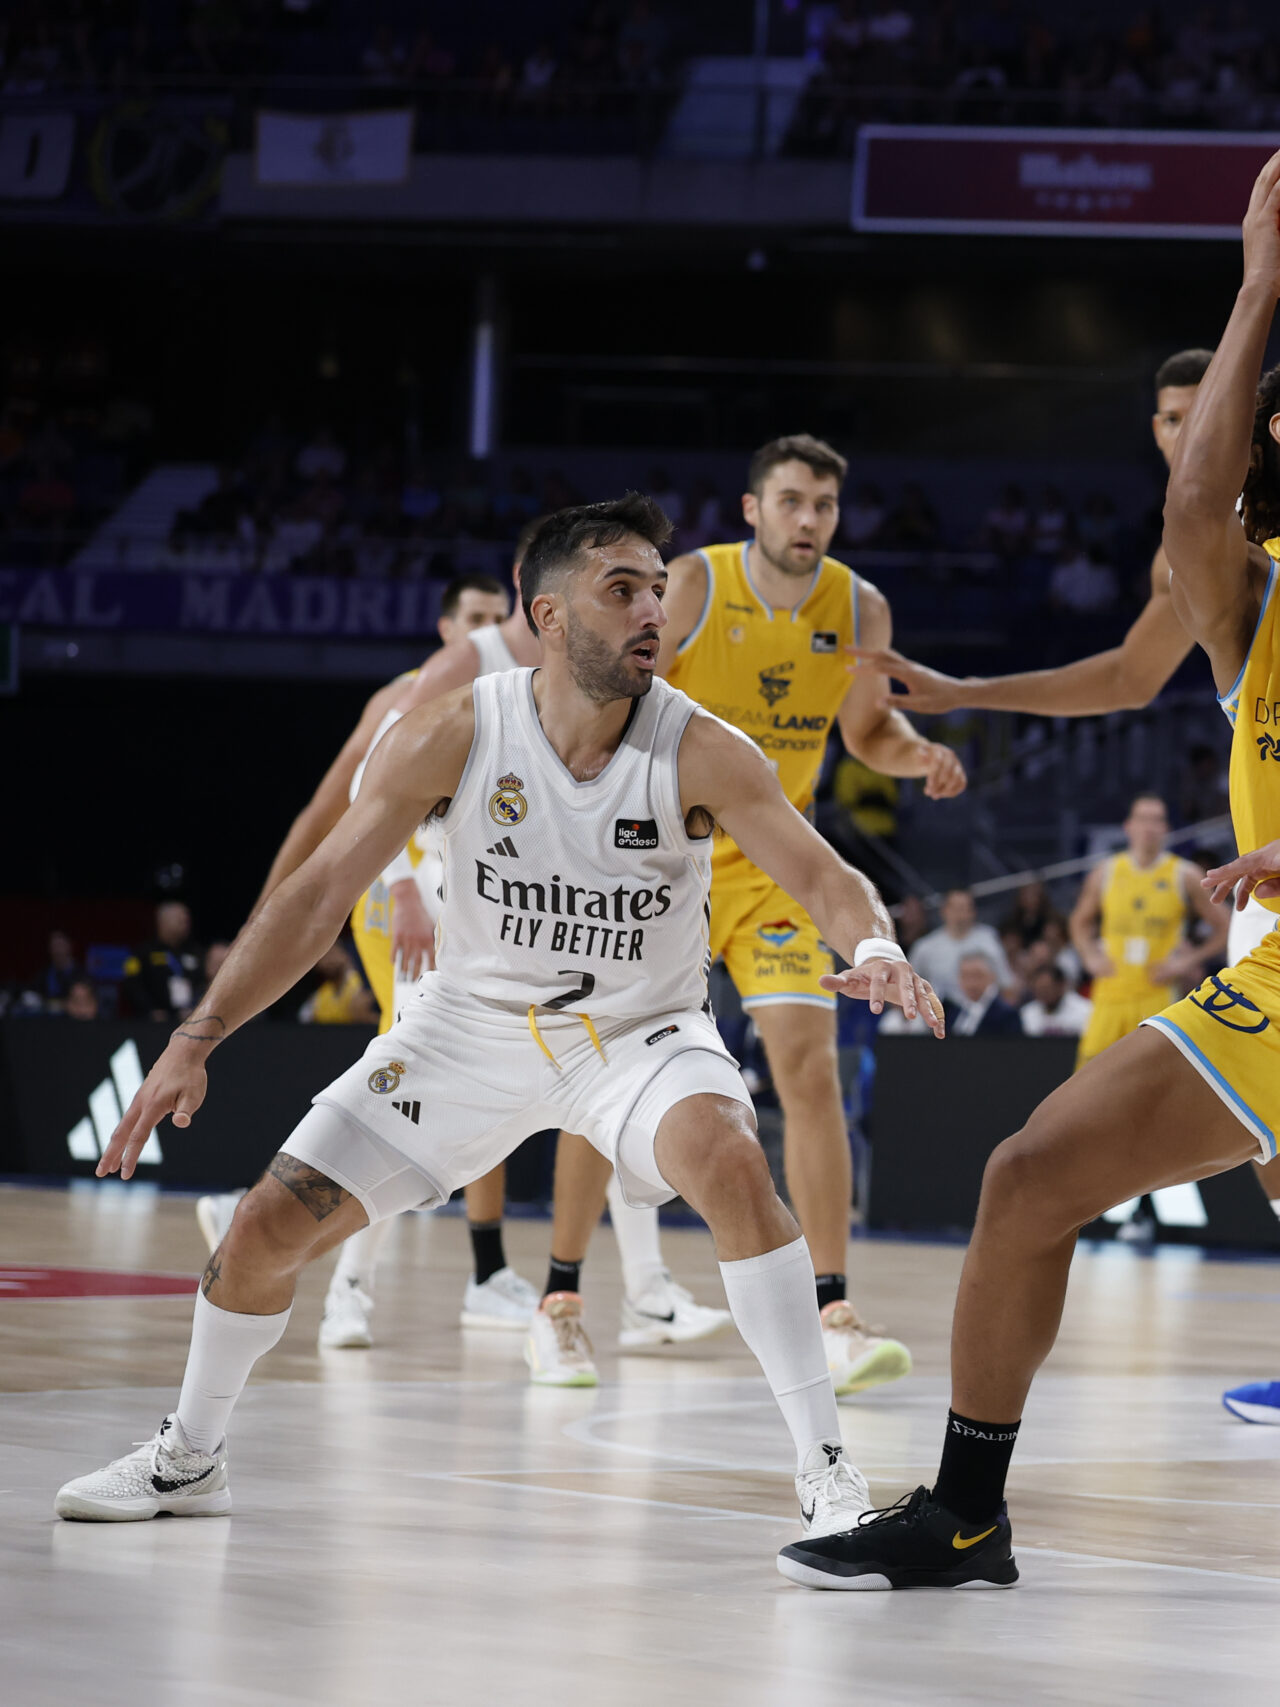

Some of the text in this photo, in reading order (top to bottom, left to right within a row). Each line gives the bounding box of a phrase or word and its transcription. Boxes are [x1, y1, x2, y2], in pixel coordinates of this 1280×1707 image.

[618, 828, 638, 838] liga
[618, 838, 657, 846] endesa
[475, 859, 671, 922] Emirates
[500, 914, 644, 961] FLY BETTER
